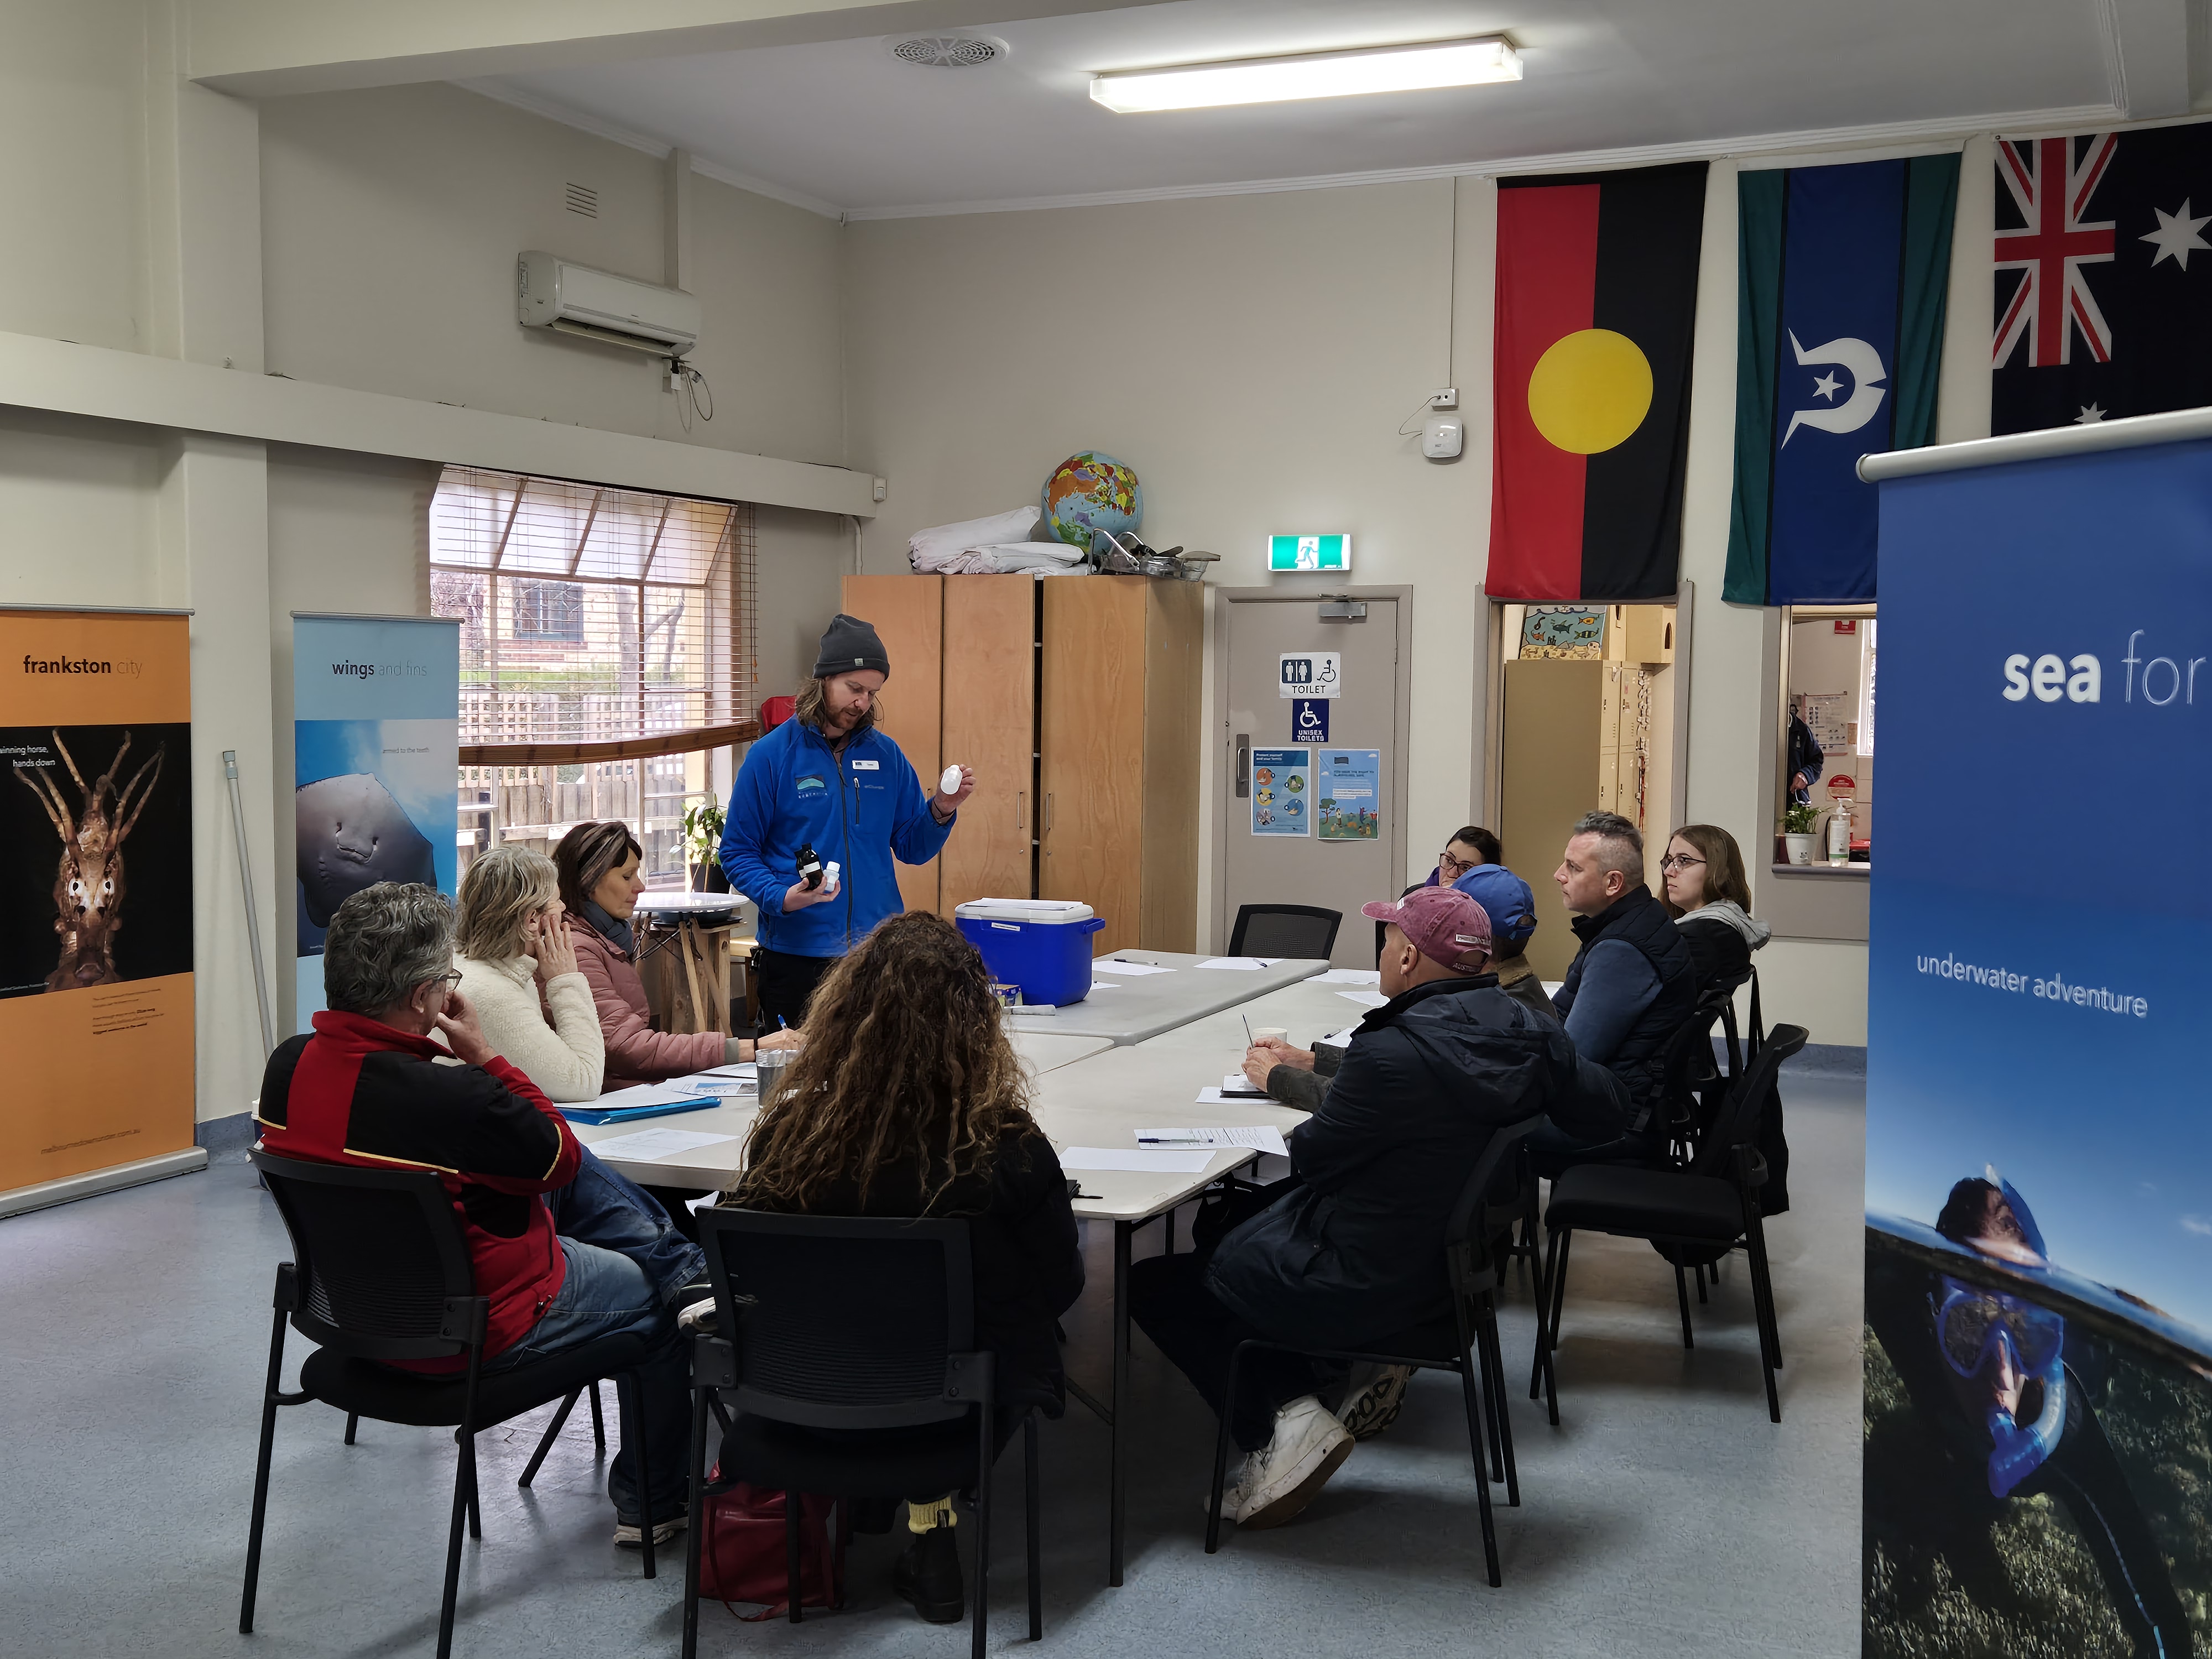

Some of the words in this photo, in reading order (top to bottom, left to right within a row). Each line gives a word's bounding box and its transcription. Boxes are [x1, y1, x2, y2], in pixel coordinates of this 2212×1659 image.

[23, 655, 111, 674] frankston
[116, 658, 142, 679] city
[332, 660, 374, 679] wings
[379, 661, 401, 676] and
[407, 660, 427, 676] fins
[2002, 654, 2101, 703] sea
[2121, 629, 2207, 705] for
[1917, 952, 2029, 993] underwater
[2033, 973, 2148, 1018] adventure
